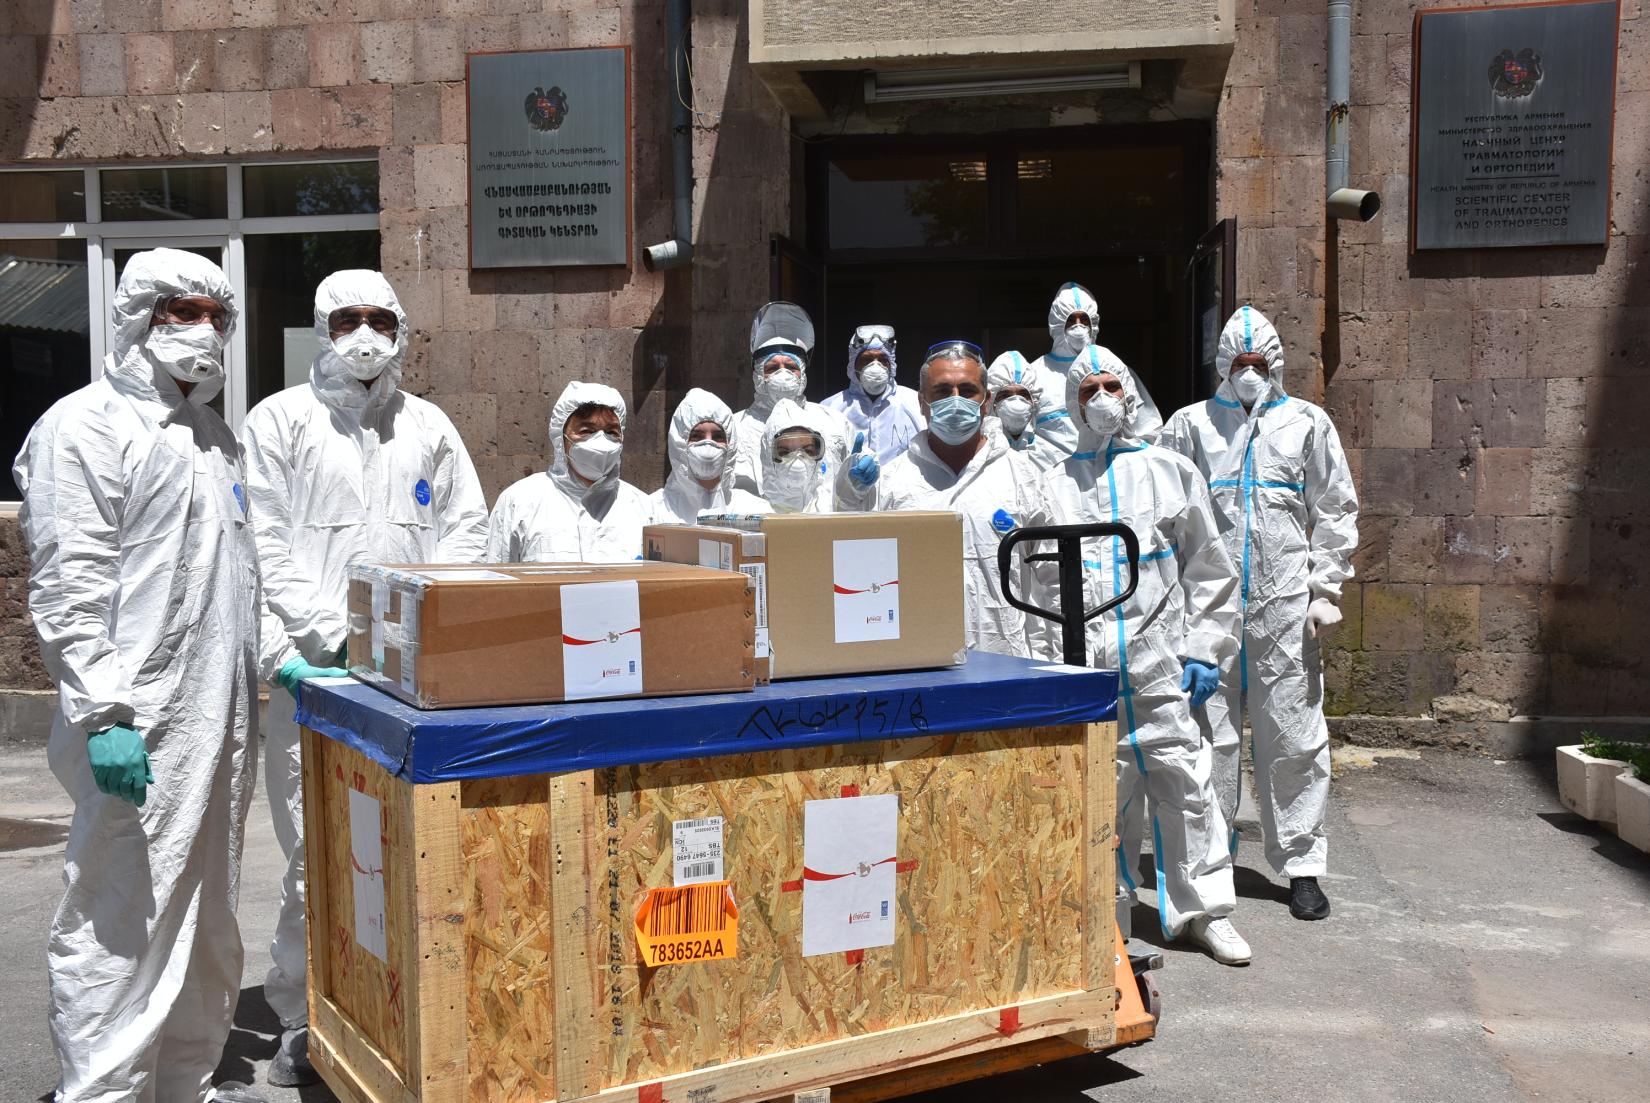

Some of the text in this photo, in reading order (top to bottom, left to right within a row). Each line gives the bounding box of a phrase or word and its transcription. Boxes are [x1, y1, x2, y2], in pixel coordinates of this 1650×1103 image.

[1465, 112, 1565, 123] РЕСПУБЛИКА АРМЕНИЯ
[1508, 122, 1592, 133] ЗДРАВООХРАНЕНИЯ
[1530, 134, 1567, 146] ЦЕНТР
[1463, 149, 1565, 161] ТРАВМАТОЛОГИИ
[1471, 162, 1555, 174] И ОРТОПЕДИИ
[1430, 179, 1596, 192] HEALTH MINISTRY OF REPUBLIC OF ARMENIA
[1455, 192, 1570, 206] SCIENTIFIC CENTER
[1454, 205, 1571, 218] OF TRAUMATOLOGY
[1455, 217, 1569, 230] AND ORTHOPEDICS
[550, 224, 598, 237] ԿԵՆՏՐՈՆ
[650, 938, 724, 963] 783652AA
